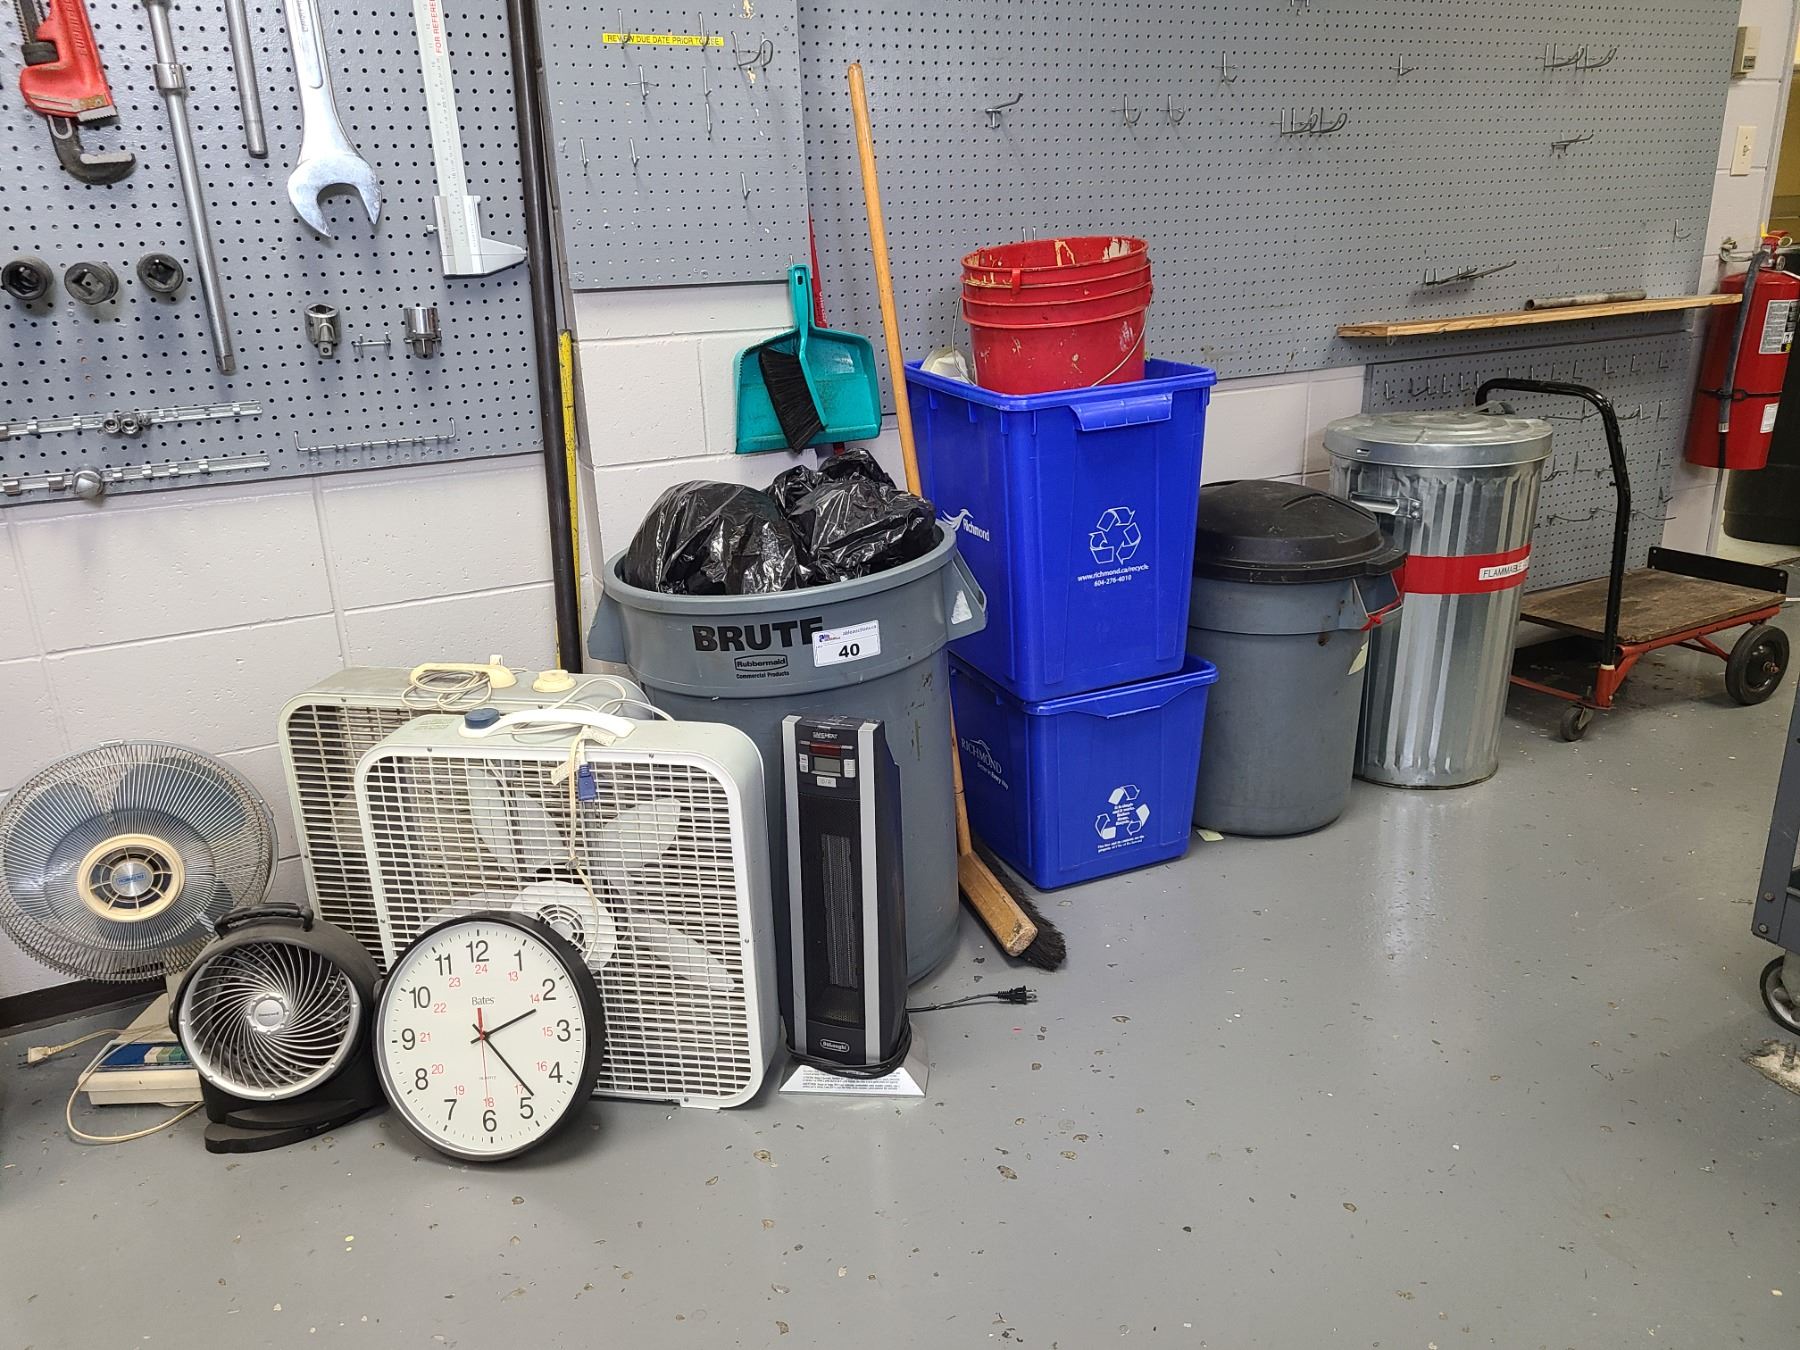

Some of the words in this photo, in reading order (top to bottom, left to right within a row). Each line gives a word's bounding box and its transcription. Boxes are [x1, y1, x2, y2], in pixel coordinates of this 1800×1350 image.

[434, 36, 442, 54] FOR
[653, 36, 670, 44] DATE
[963, 518, 990, 541] Richmond
[1093, 574, 1132, 587] 604-276-4010
[692, 617, 823, 652] BRUTE
[838, 643, 860, 658] 40
[737, 658, 785, 667] Rubbermaid
[466, 940, 490, 963] 12
[435, 954, 452, 976] 11
[513, 949, 523, 971] 1
[475, 964, 488, 975] 24
[507, 971, 518, 982] 13
[448, 977, 462, 988] 23
[542, 979, 557, 1001] 2
[409, 986, 431, 1009] 10
[471, 996, 495, 1006] Bates
[530, 993, 541, 1004] 14
[434, 1003, 447, 1014] 22
[419, 1032, 431, 1043] 21
[542, 1027, 553, 1037] 15
[556, 1019, 571, 1042] 3
[401, 1028, 416, 1051] 9
[431, 1064, 444, 1075] 20
[536, 1061, 548, 1072] 16
[548, 1062, 563, 1084] 4
[415, 1068, 429, 1091] 8
[453, 1085, 465, 1096] 19
[514, 1084, 525, 1095] 17
[444, 1098, 458, 1121] 7
[484, 1097, 495, 1108] 18
[520, 1097, 534, 1119] 5
[482, 1109, 497, 1132] 6
